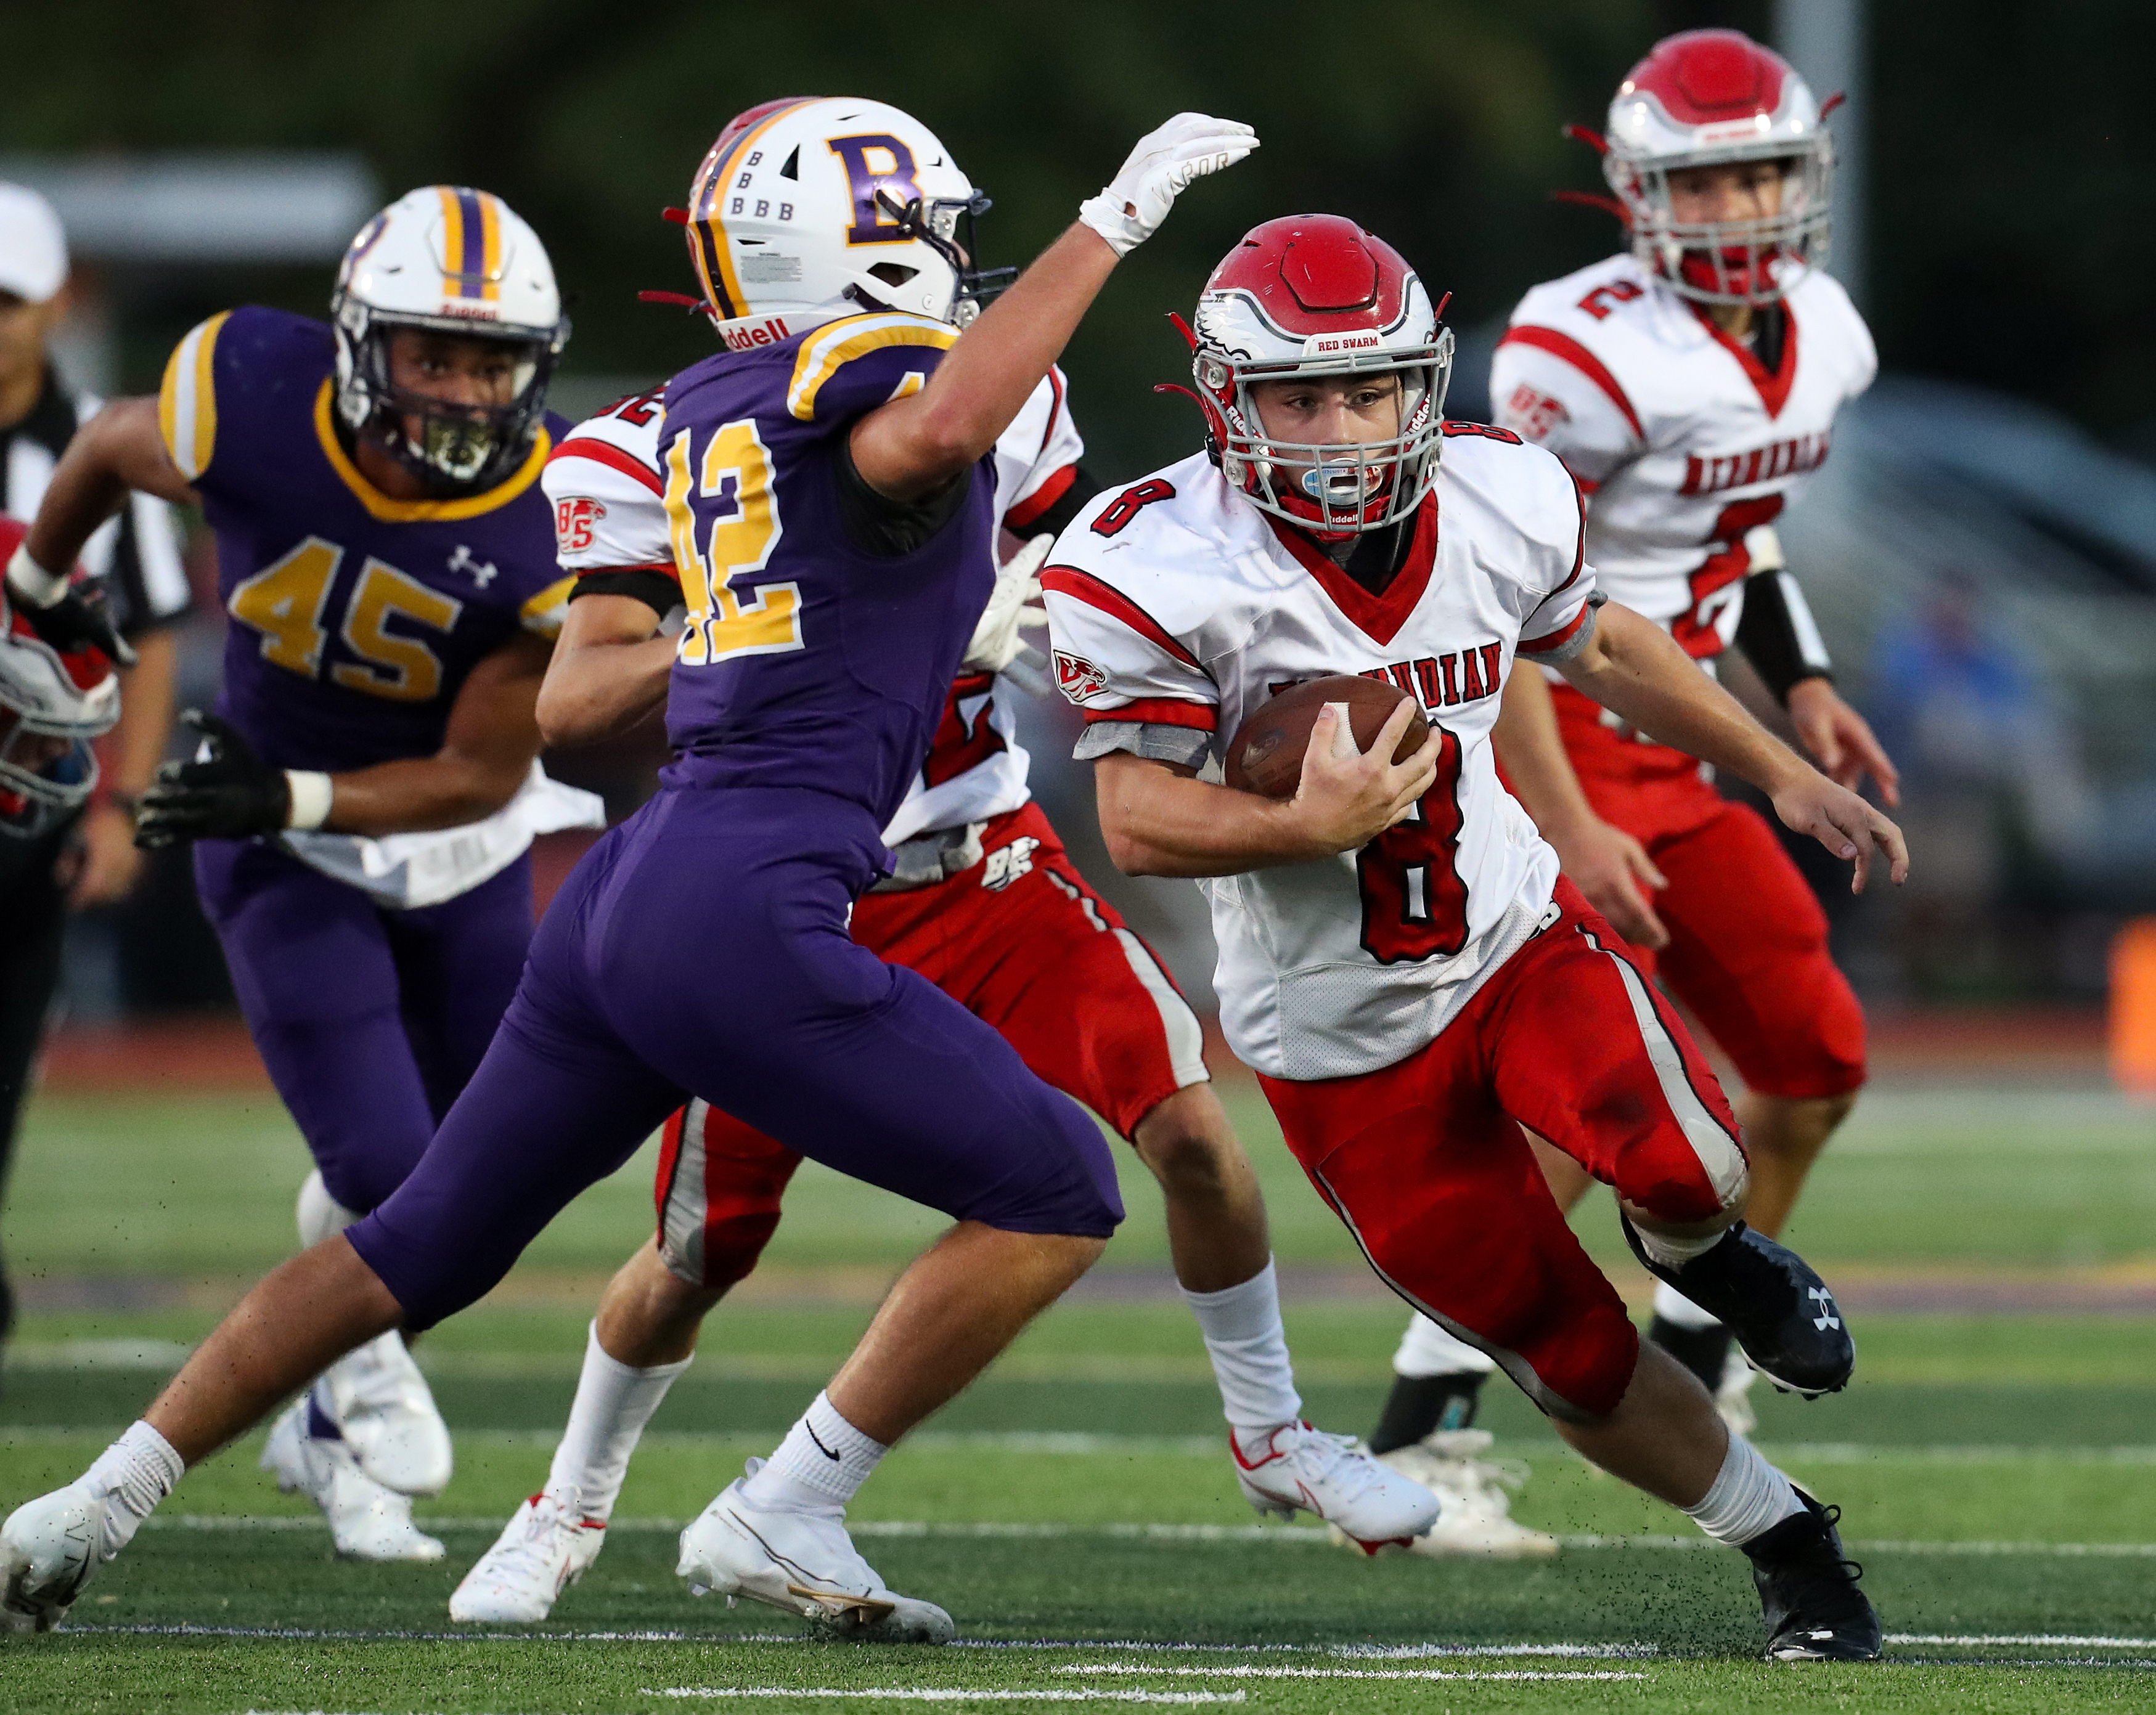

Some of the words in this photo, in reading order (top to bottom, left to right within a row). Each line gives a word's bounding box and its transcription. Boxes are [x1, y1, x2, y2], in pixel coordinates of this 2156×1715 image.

[746, 151, 763, 166] B
[737, 173, 752, 189] B
[824, 132, 925, 248] B
[731, 197, 744, 214] B
[754, 199, 769, 217] B
[778, 202, 794, 221] B
[1578, 280, 1644, 320] 2
[724, 318, 790, 349] ddell
[1318, 340, 1339, 351] RED
[1342, 336, 1379, 349] SWARM
[1440, 420, 1524, 446] 8
[1090, 478, 1176, 538] 8
[663, 418, 806, 666] 42
[1672, 492, 1786, 659] 2
[227, 534, 463, 703] 45
[1357, 718, 1470, 966] 8
